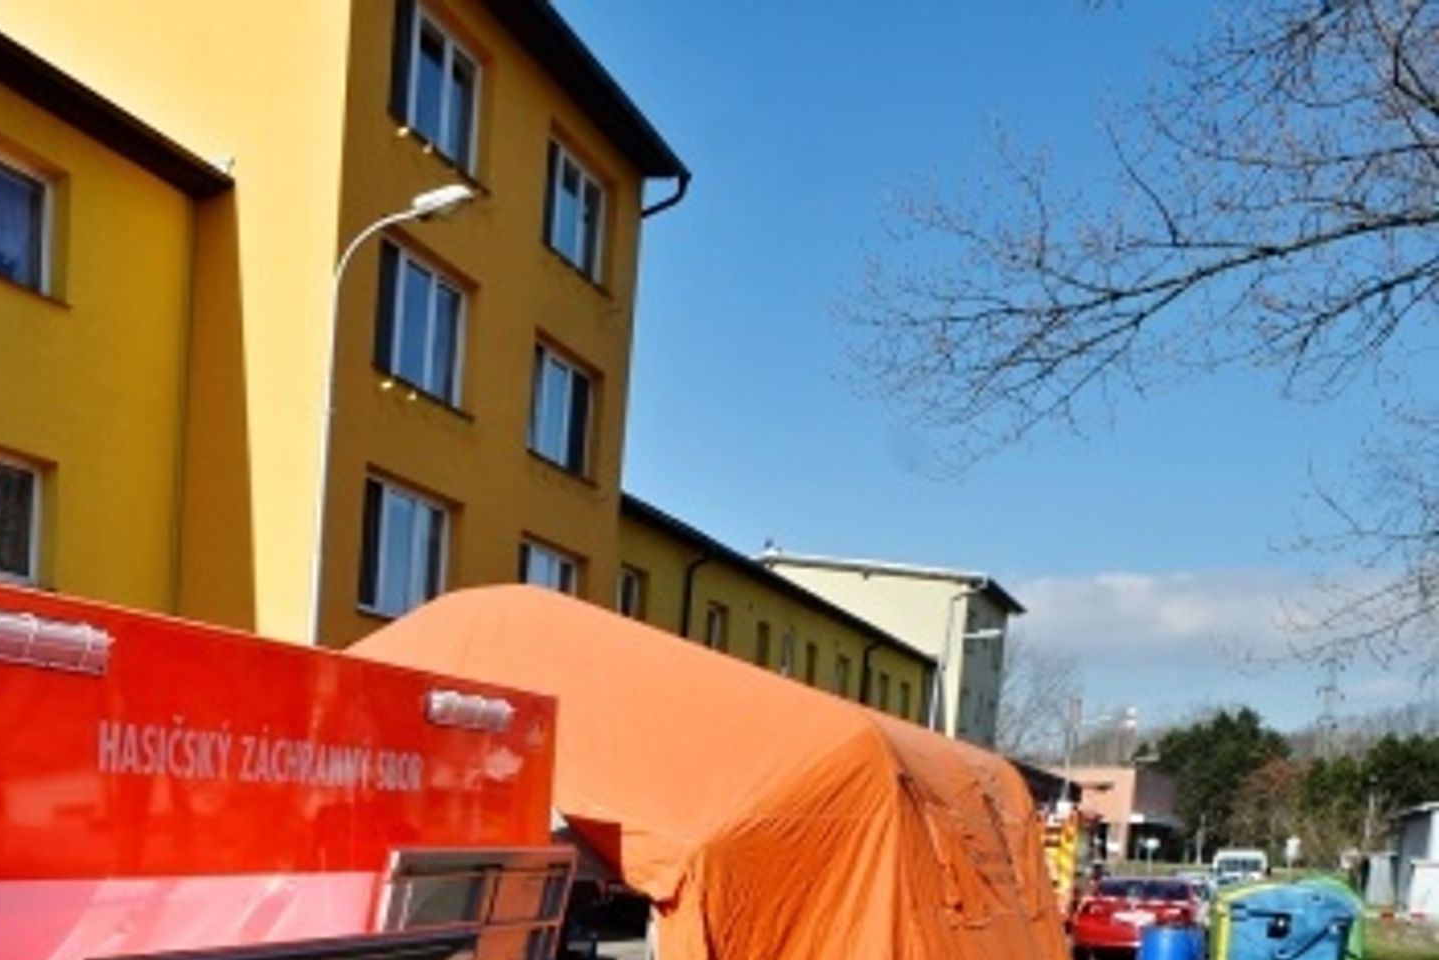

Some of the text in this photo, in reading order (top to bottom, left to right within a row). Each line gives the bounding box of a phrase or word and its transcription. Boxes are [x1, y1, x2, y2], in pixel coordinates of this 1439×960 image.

[98, 714, 424, 792] HASIČSKÝ ZÁCHRANNÝ SBOR
